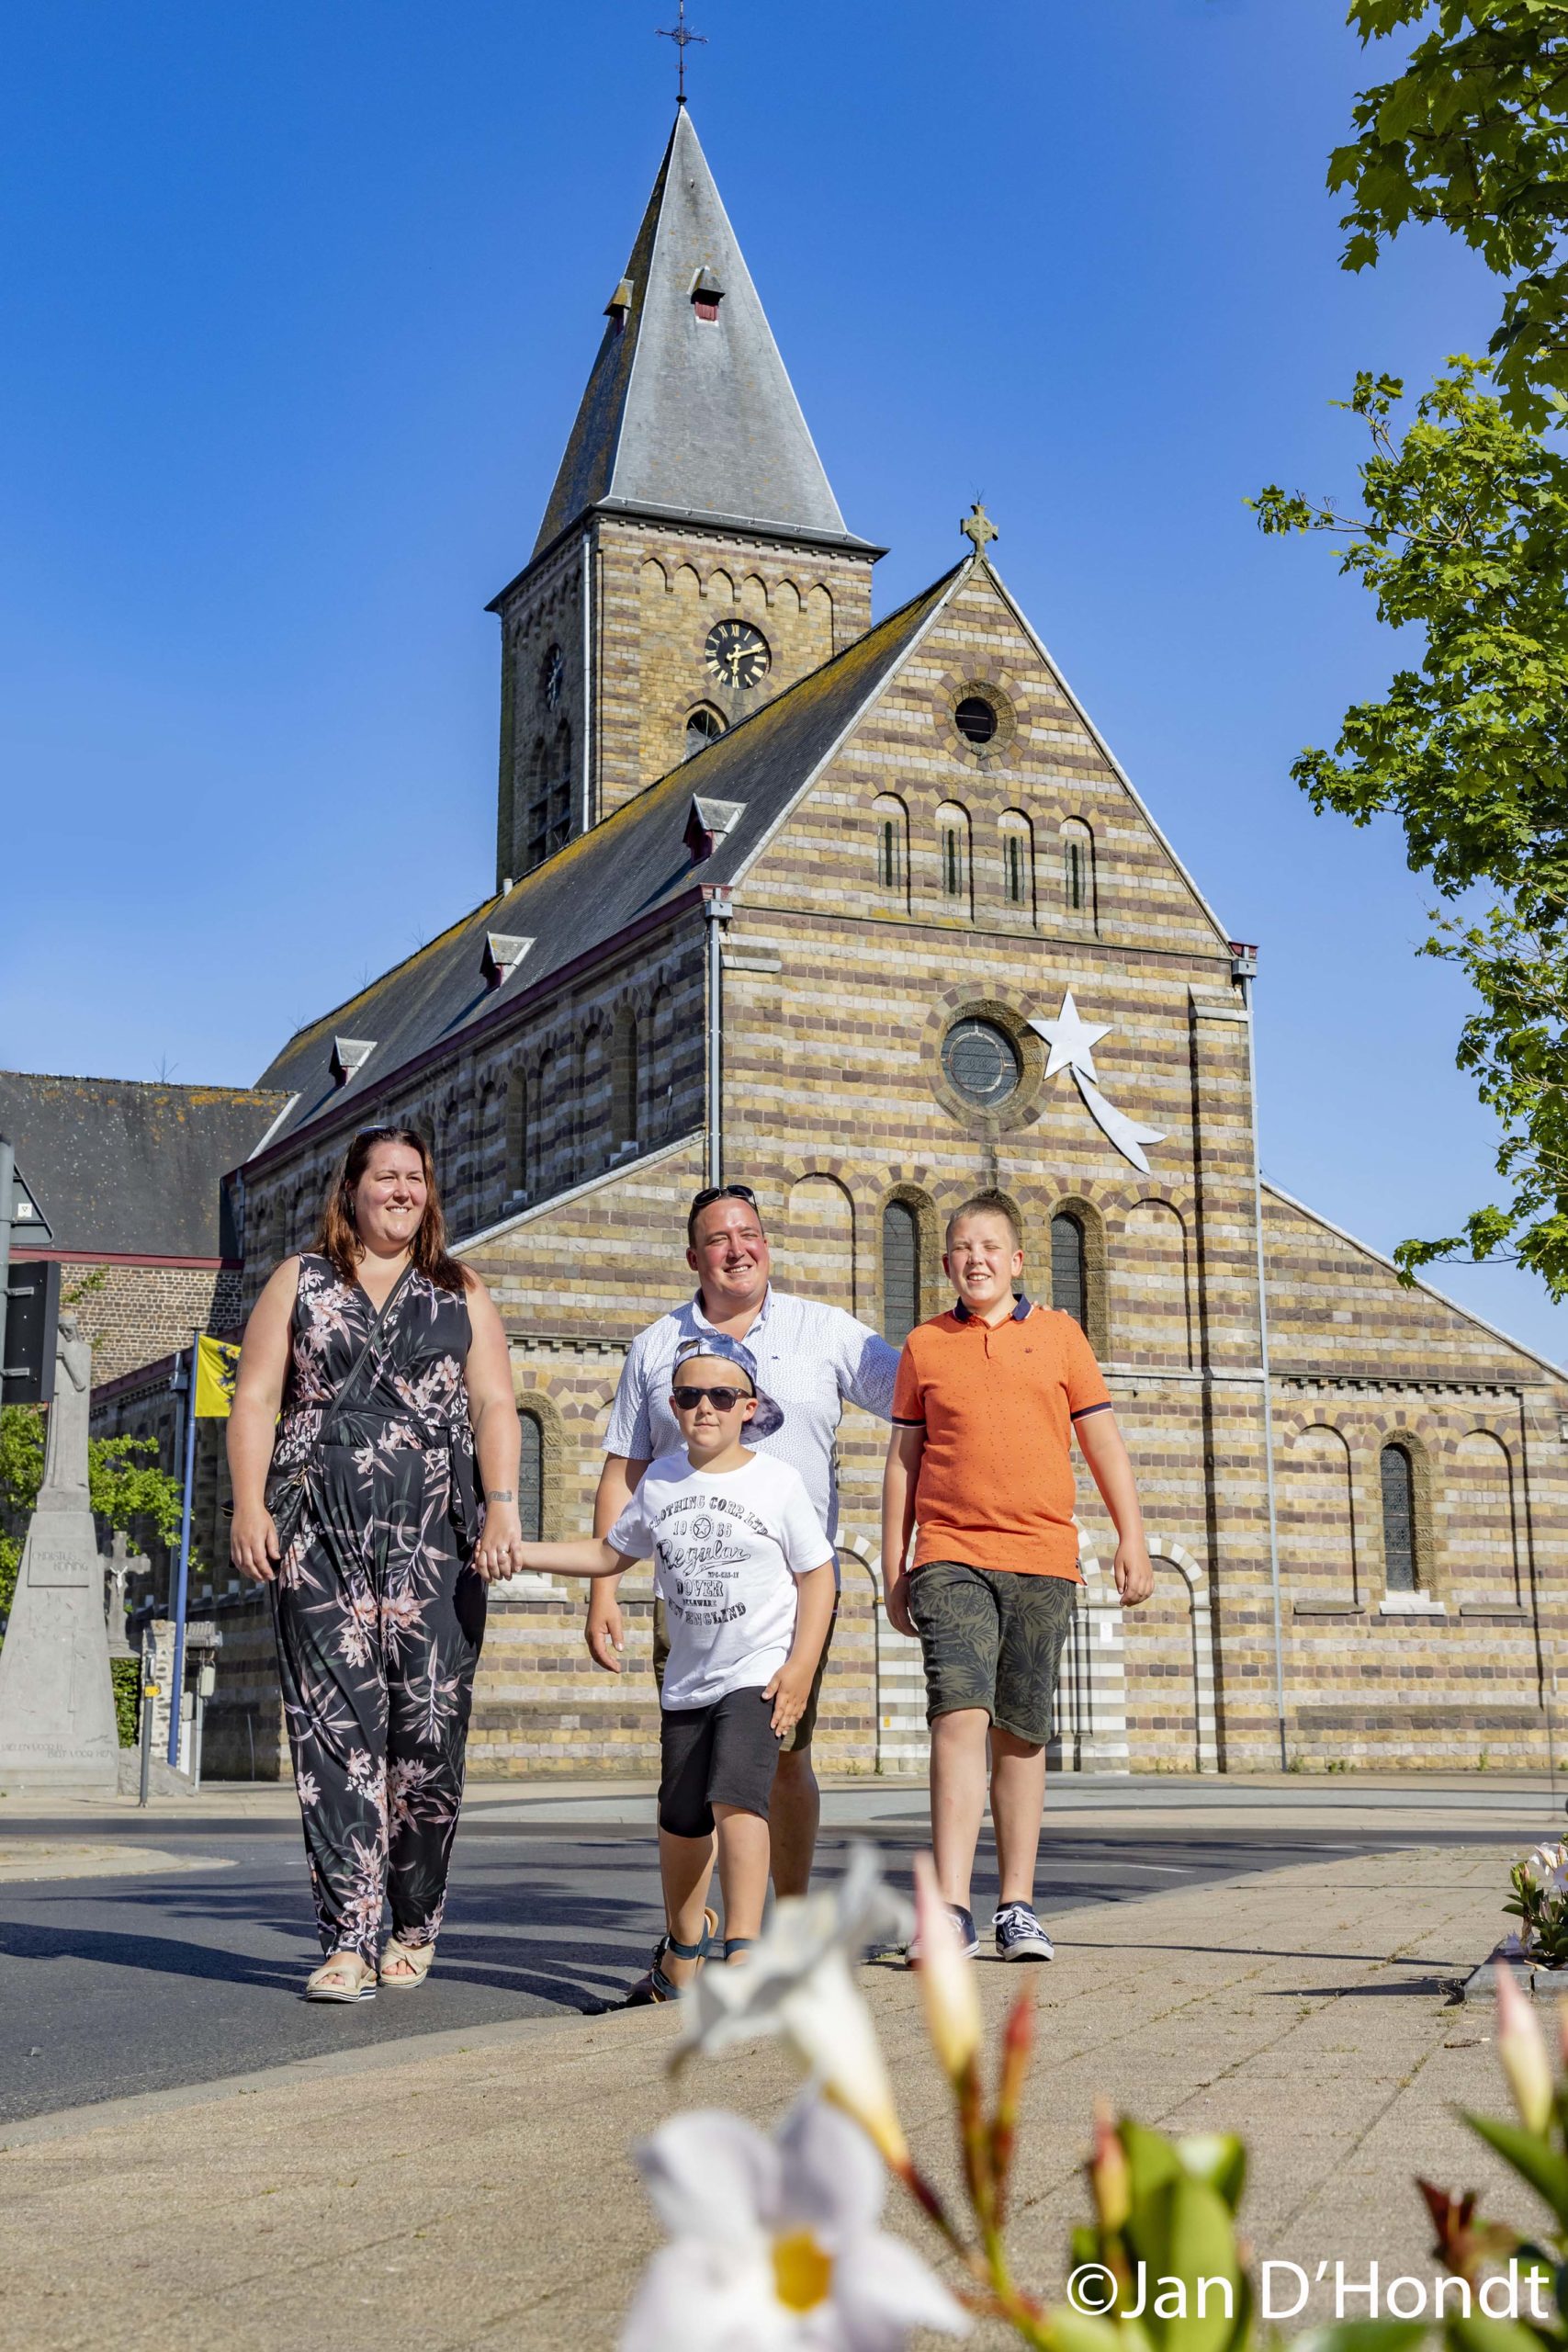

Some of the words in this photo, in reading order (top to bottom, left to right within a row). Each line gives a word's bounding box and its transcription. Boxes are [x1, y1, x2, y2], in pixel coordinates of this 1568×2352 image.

[649, 1496, 705, 1532] CLOTHING
[744, 1511, 768, 1535] LTD
[672, 1521, 687, 1536] 19
[716, 1522, 732, 1537] 86
[656, 1539, 751, 1577] Regular
[675, 1578, 724, 1597] DOVER
[682, 1599, 717, 1607] DELAWARE
[684, 1602, 747, 1625] ENGLAND
